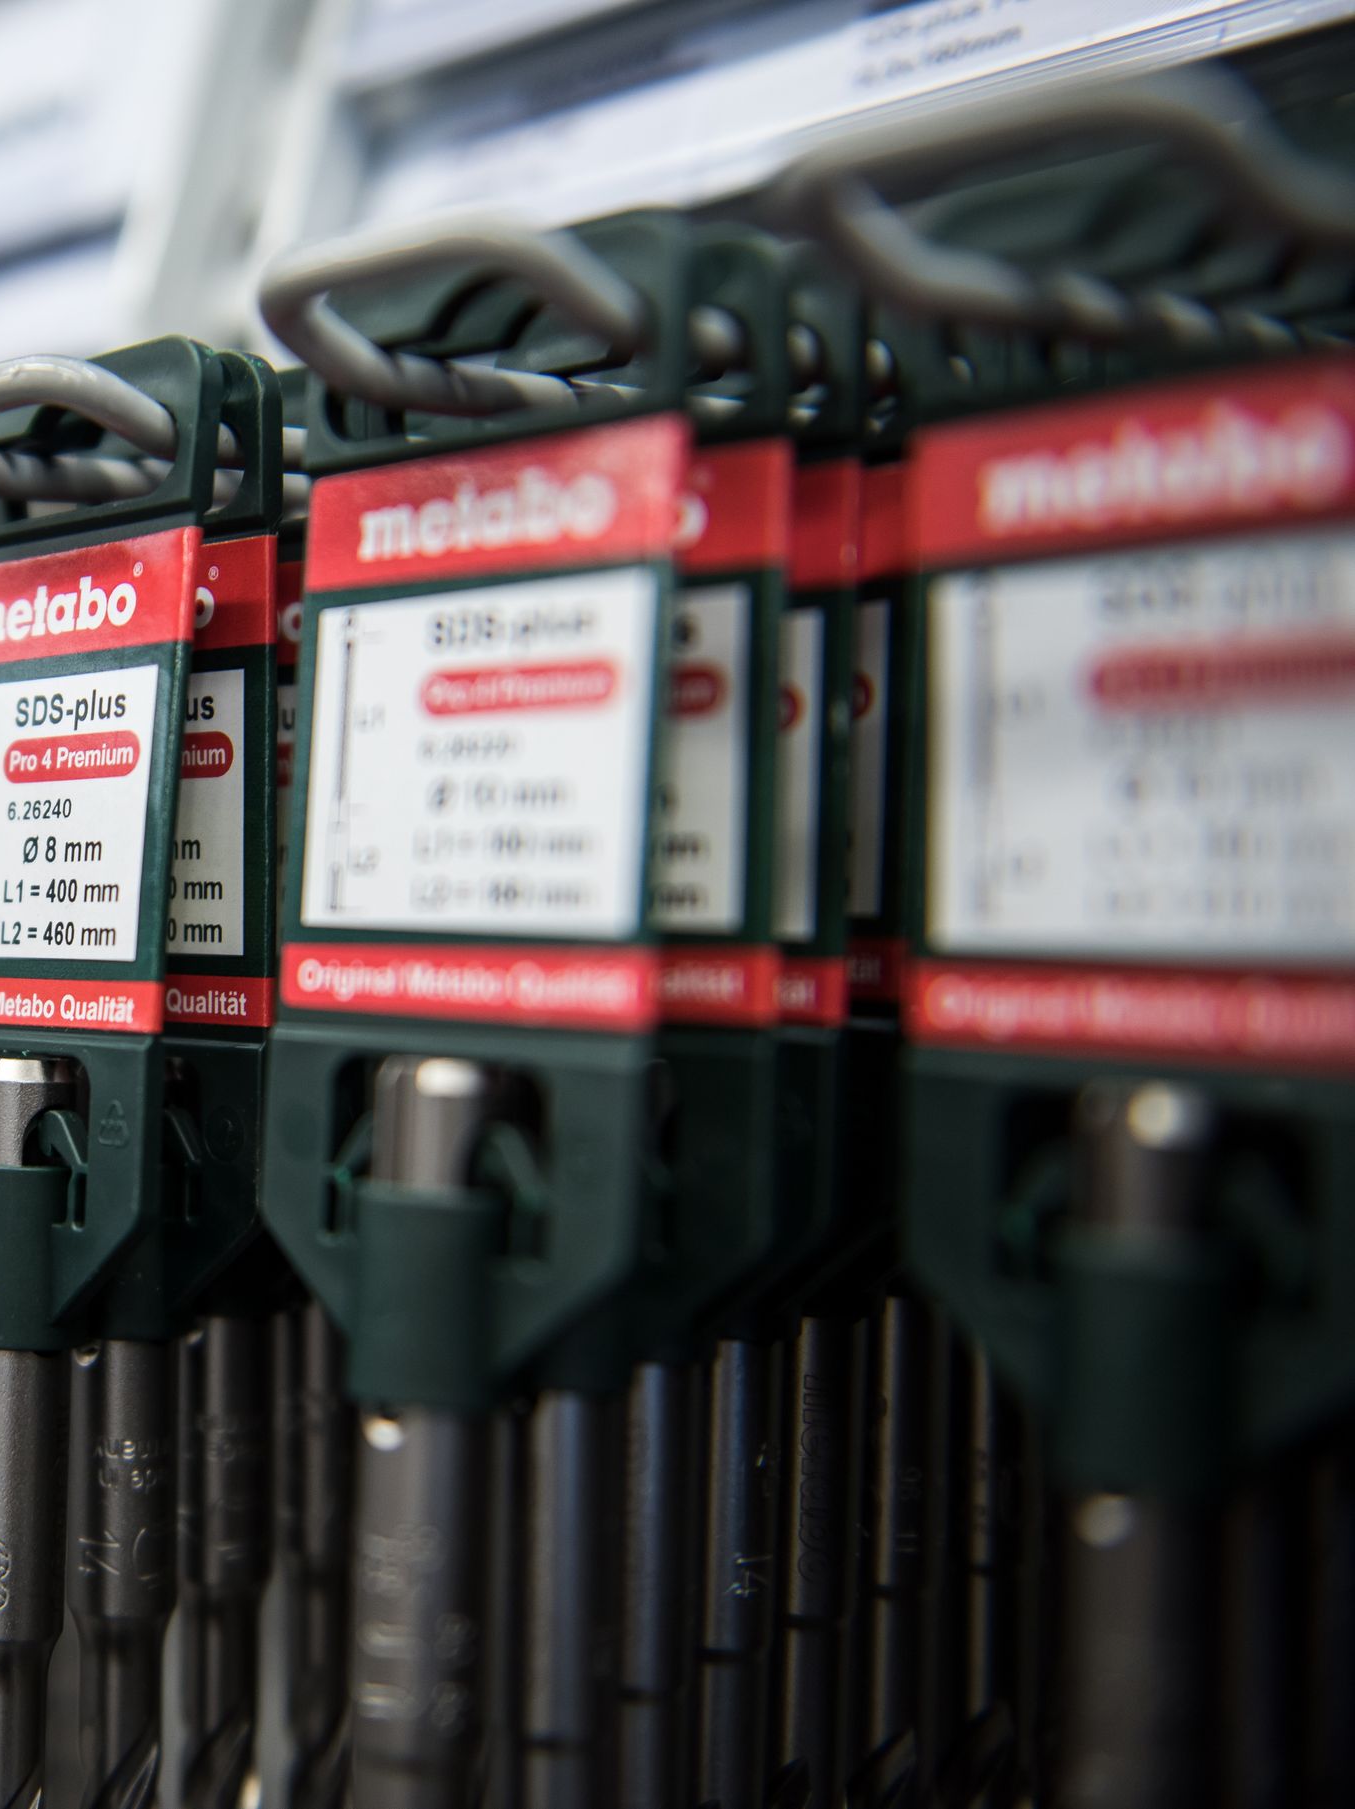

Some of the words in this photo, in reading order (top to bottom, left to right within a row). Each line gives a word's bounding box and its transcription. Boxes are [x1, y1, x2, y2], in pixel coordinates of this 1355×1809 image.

[15, 689, 127, 731] SDS-plus
[8, 750, 38, 773] Pro
[41, 748, 52, 769] 4
[56, 743, 134, 769] Premium
[8, 798, 72, 820] 6.26240
[45, 836, 57, 862] 8
[64, 840, 102, 862] mm
[3, 879, 24, 903] L1
[30, 885, 40, 896] =
[45, 878, 78, 903] 400
[83, 883, 120, 903] mm
[183, 880, 223, 901] mm
[0, 921, 21, 945] L2
[27, 927, 37, 938] =
[43, 921, 75, 946] 460
[80, 927, 117, 946] mm
[183, 923, 223, 943] mm
[60, 993, 135, 1024] Qualität
[166, 988, 247, 1017] Qualität
